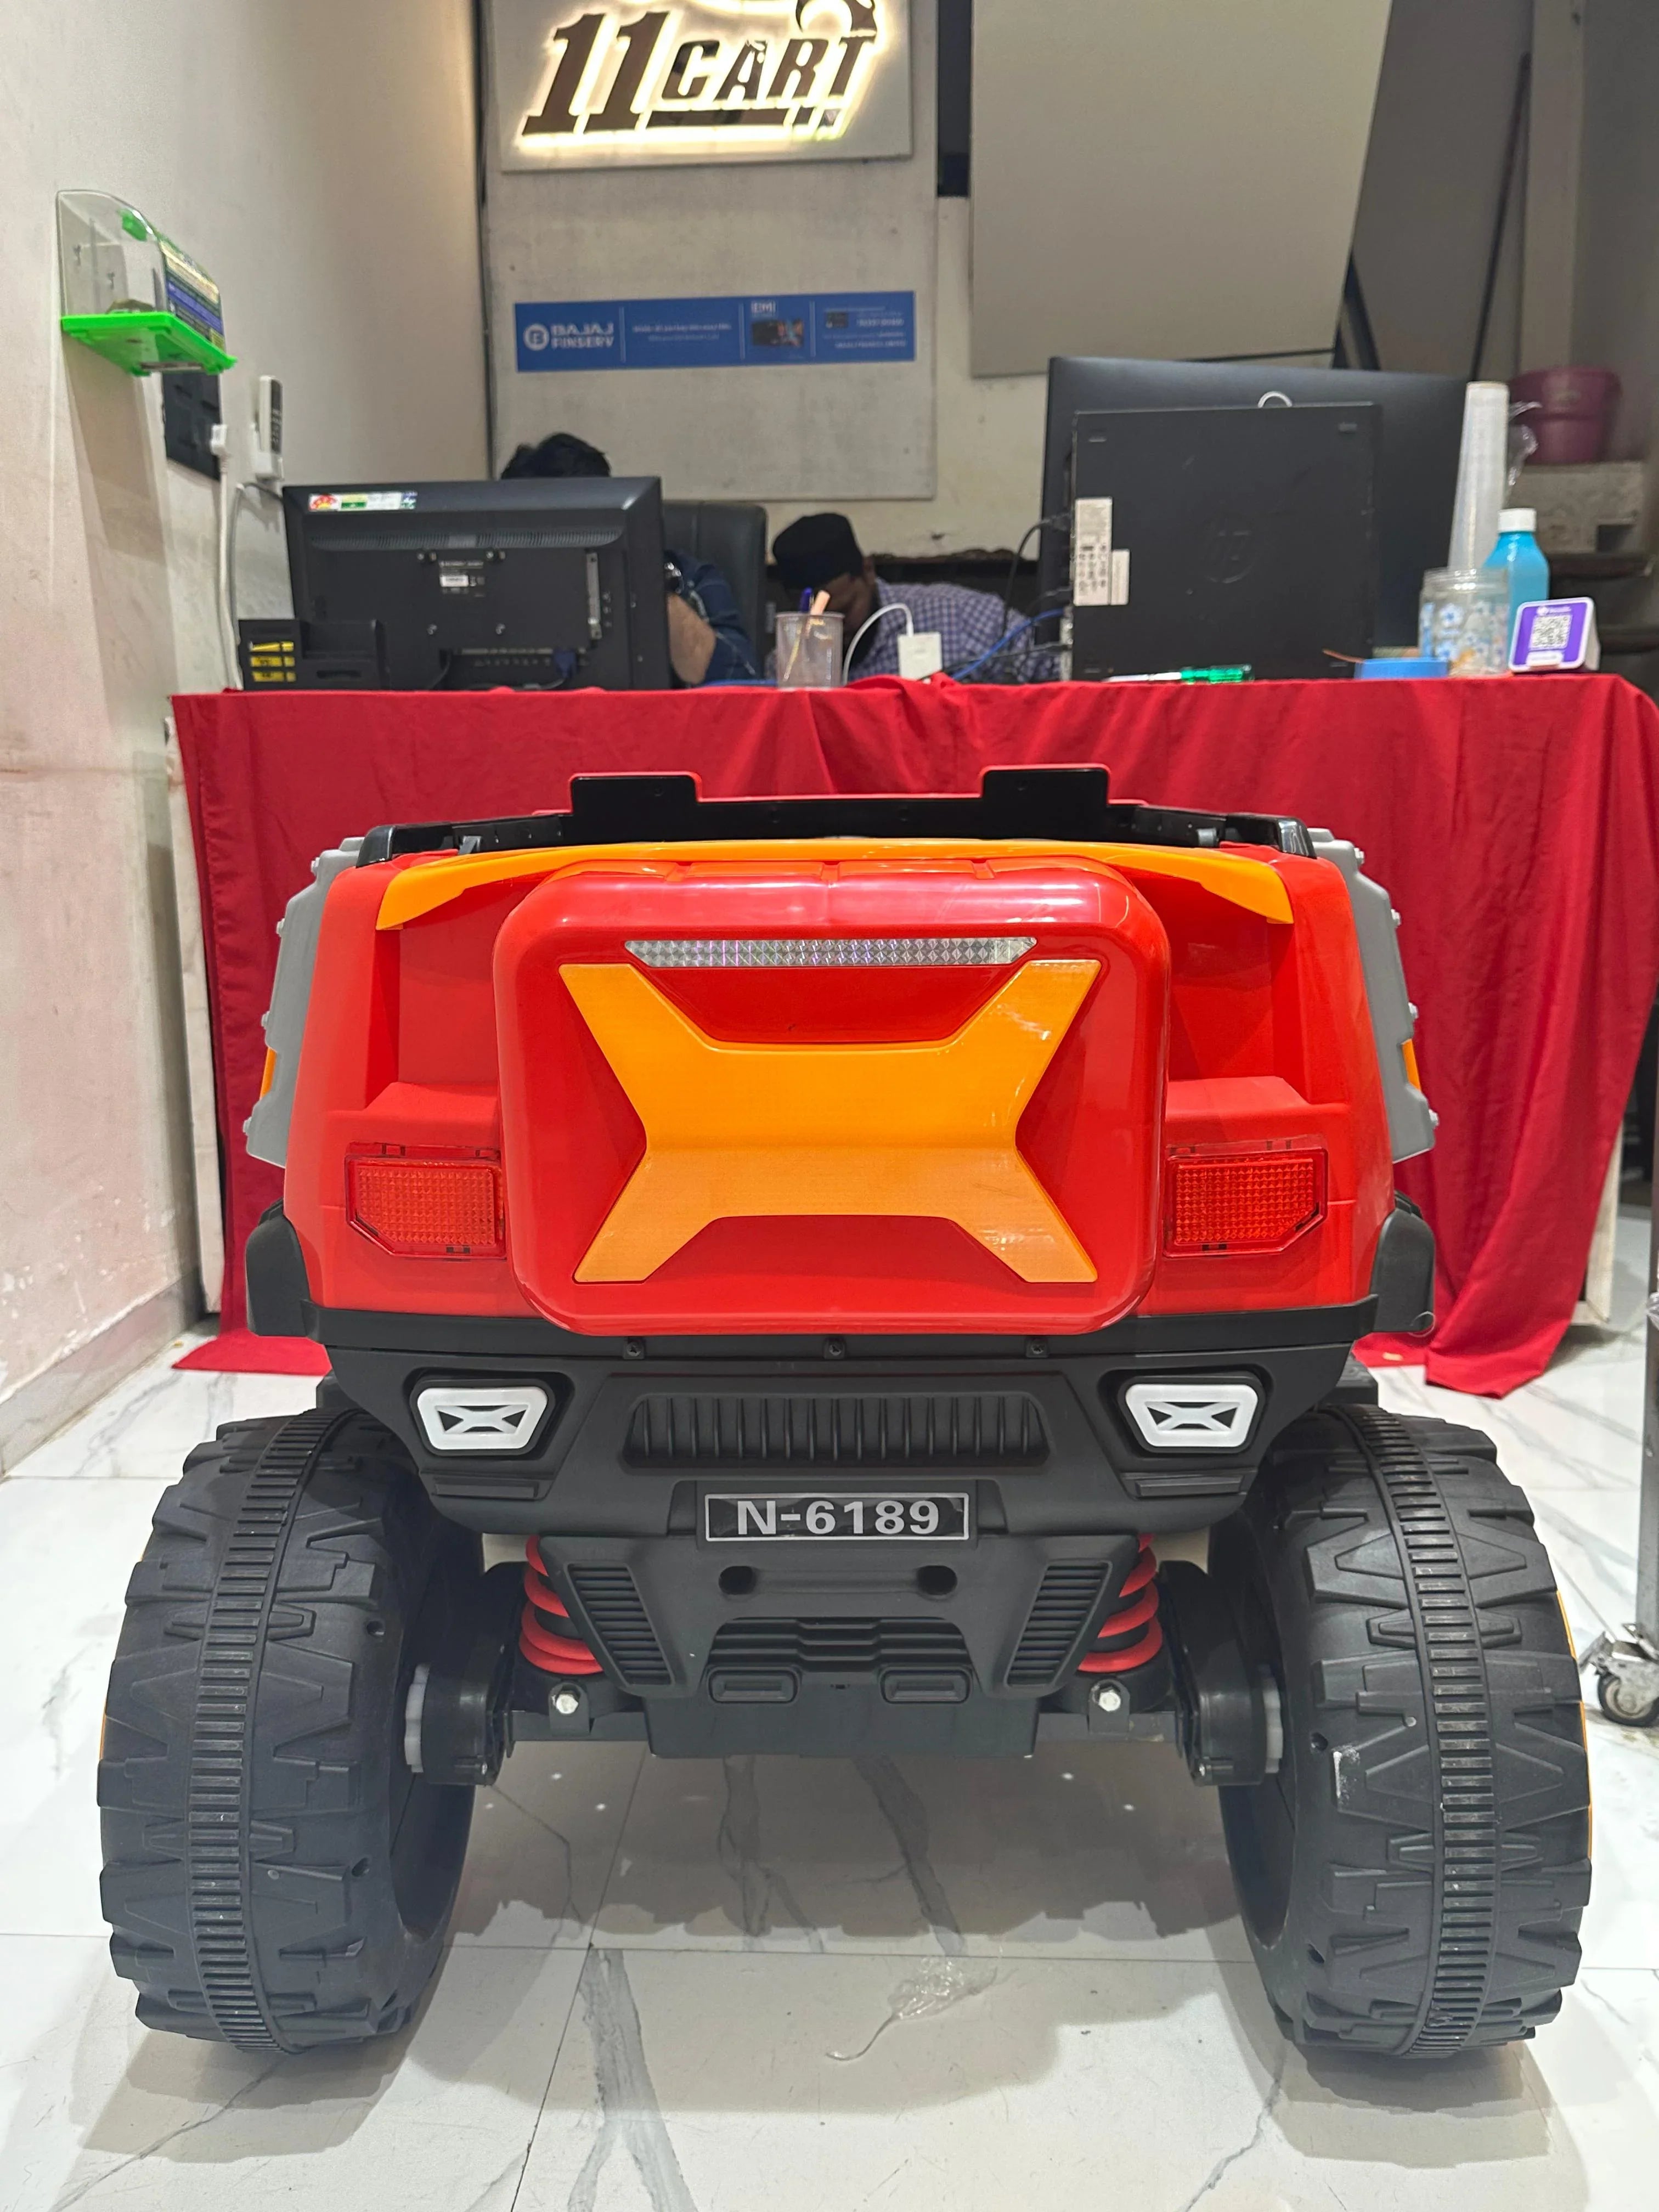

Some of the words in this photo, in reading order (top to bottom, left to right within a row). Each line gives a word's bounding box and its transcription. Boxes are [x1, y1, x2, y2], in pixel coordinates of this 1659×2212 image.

[550, 322, 614, 336] BAJAJ
[550, 336, 614, 349] FINSERV
[737, 1500, 939, 1534] N-6189
